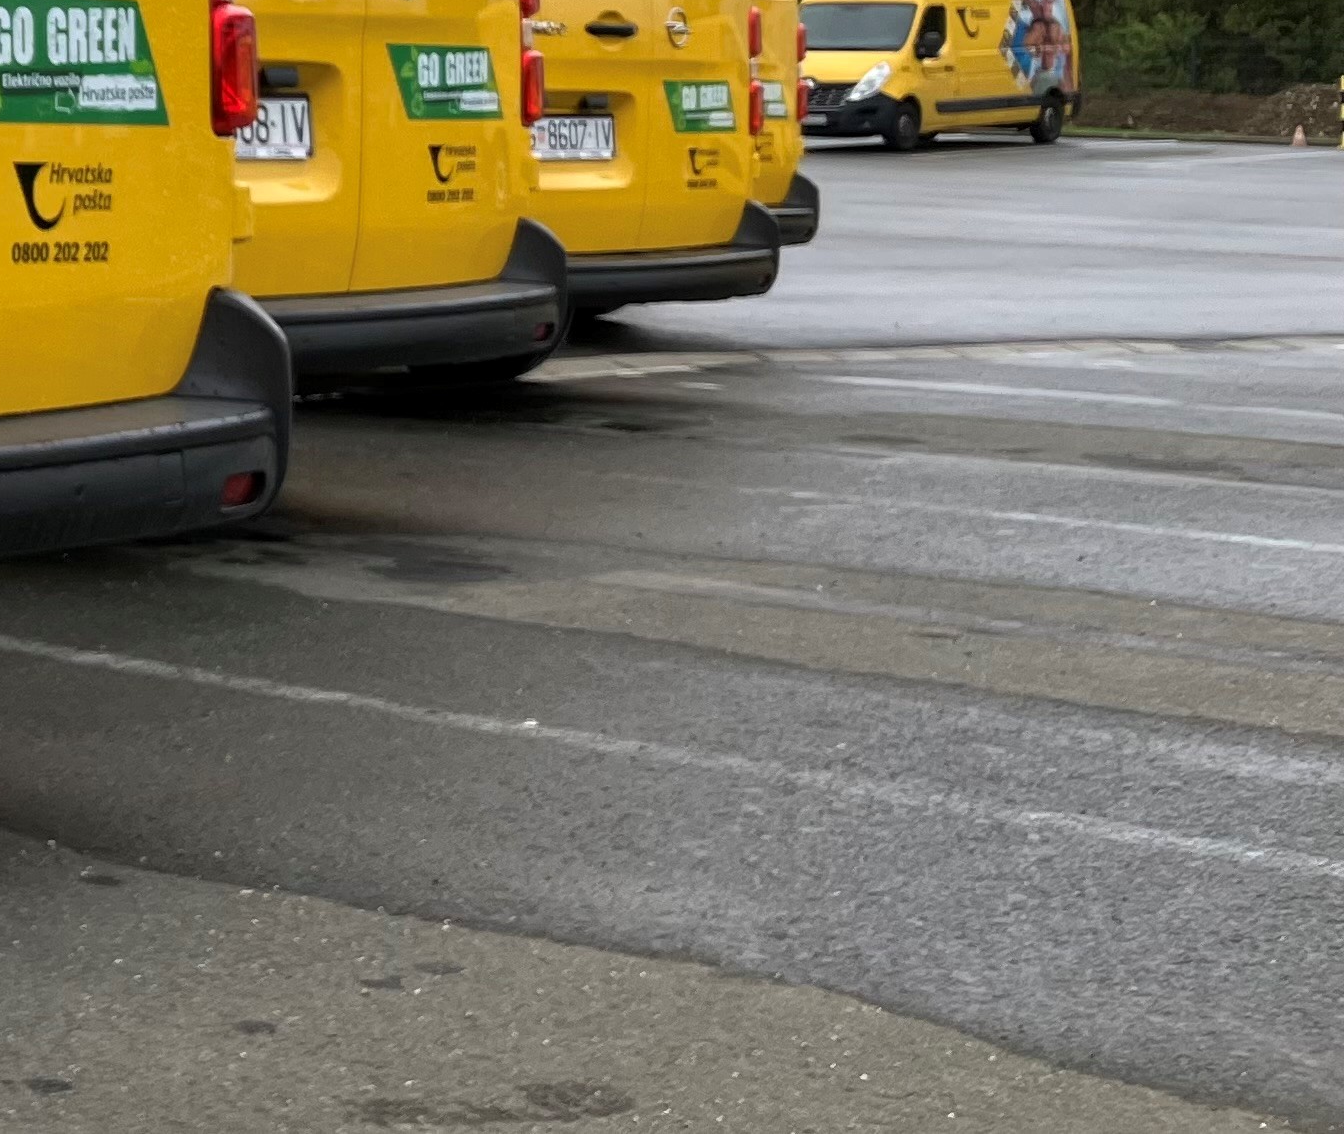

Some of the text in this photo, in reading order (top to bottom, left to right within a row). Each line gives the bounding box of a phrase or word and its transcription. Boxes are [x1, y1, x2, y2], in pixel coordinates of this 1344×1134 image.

[46, 5, 136, 66] GREEN
[49, 161, 113, 185] Hrvatska
[12, 240, 109, 264] 0800 202 202
